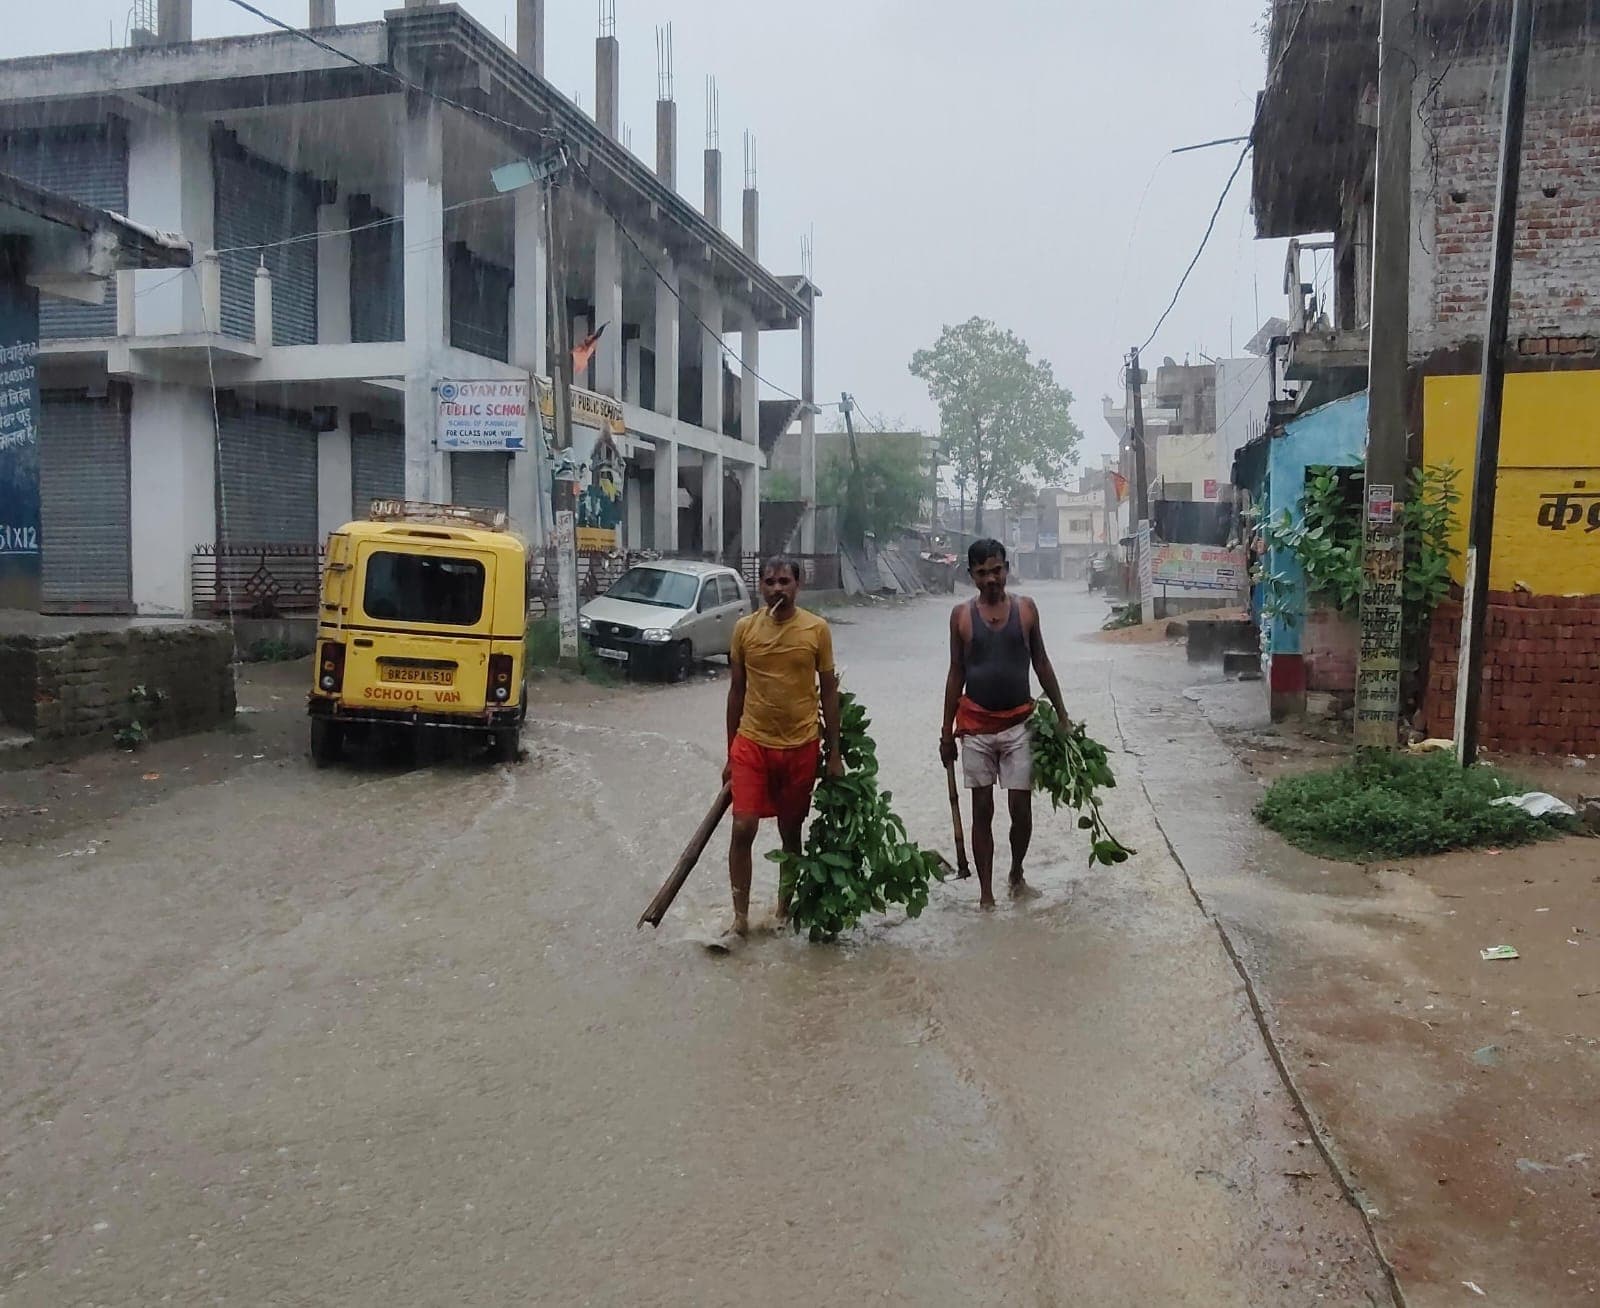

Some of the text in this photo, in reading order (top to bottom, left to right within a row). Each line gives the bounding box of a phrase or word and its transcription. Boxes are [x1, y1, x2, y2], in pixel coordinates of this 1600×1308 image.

[460, 384, 496, 397] GYAN
[439, 404, 526, 416] PUBLIC SCHOOL
[363, 687, 461, 703] SCHOOL VAN
